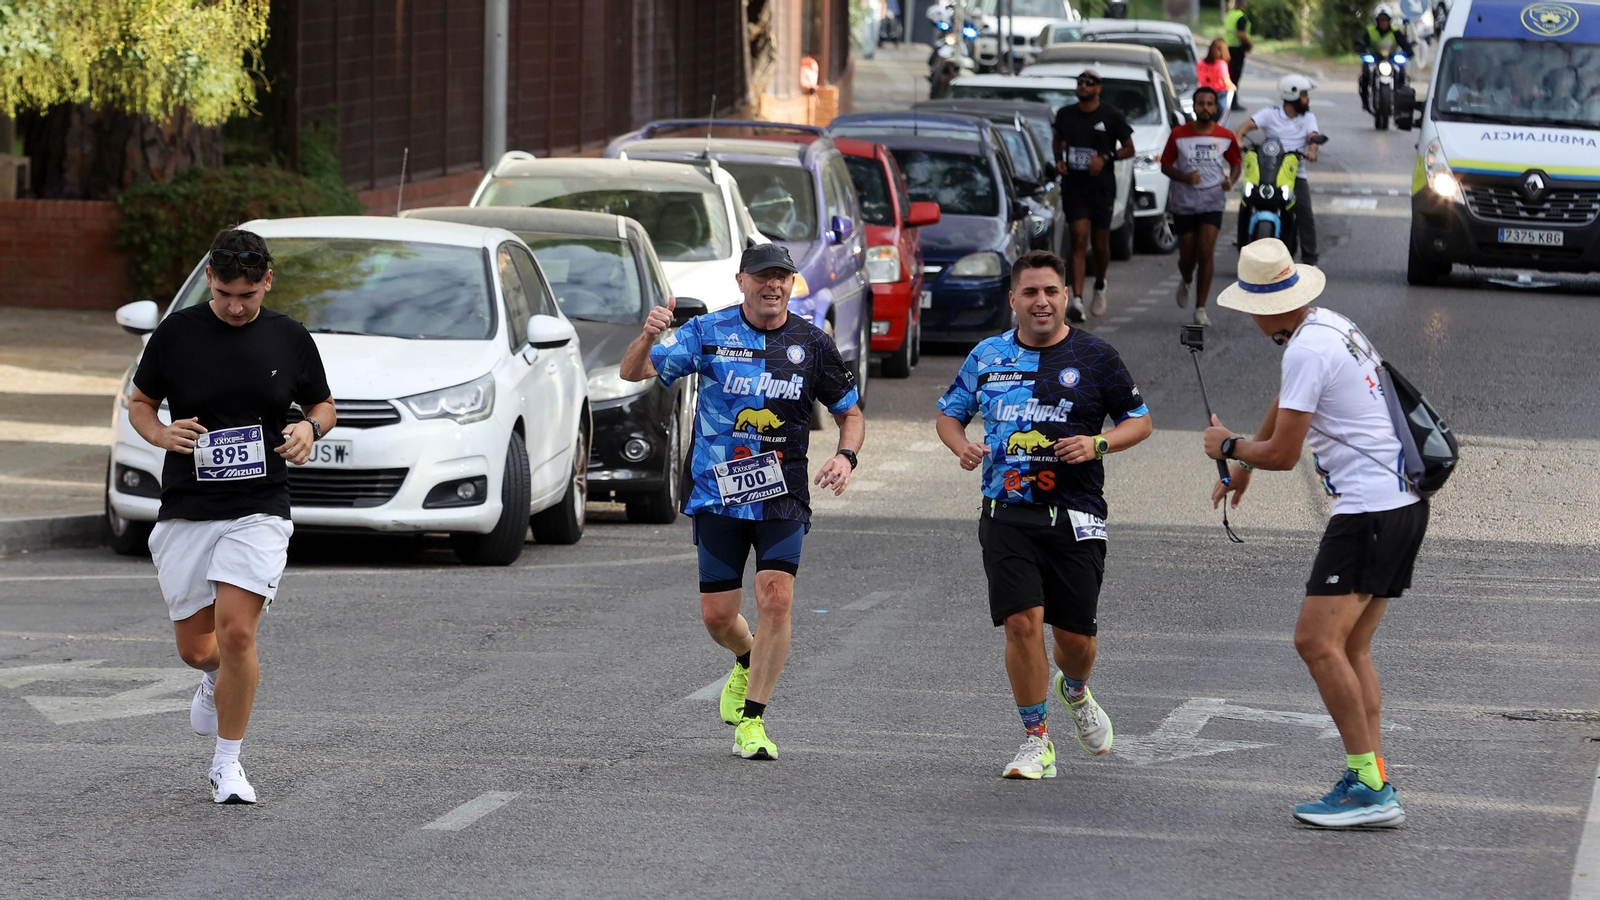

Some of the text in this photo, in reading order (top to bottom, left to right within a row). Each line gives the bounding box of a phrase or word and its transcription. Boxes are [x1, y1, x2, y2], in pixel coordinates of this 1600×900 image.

[1505, 230, 1561, 244] 7375 KBG
[212, 445, 249, 465] 895
[732, 470, 767, 491] 700
